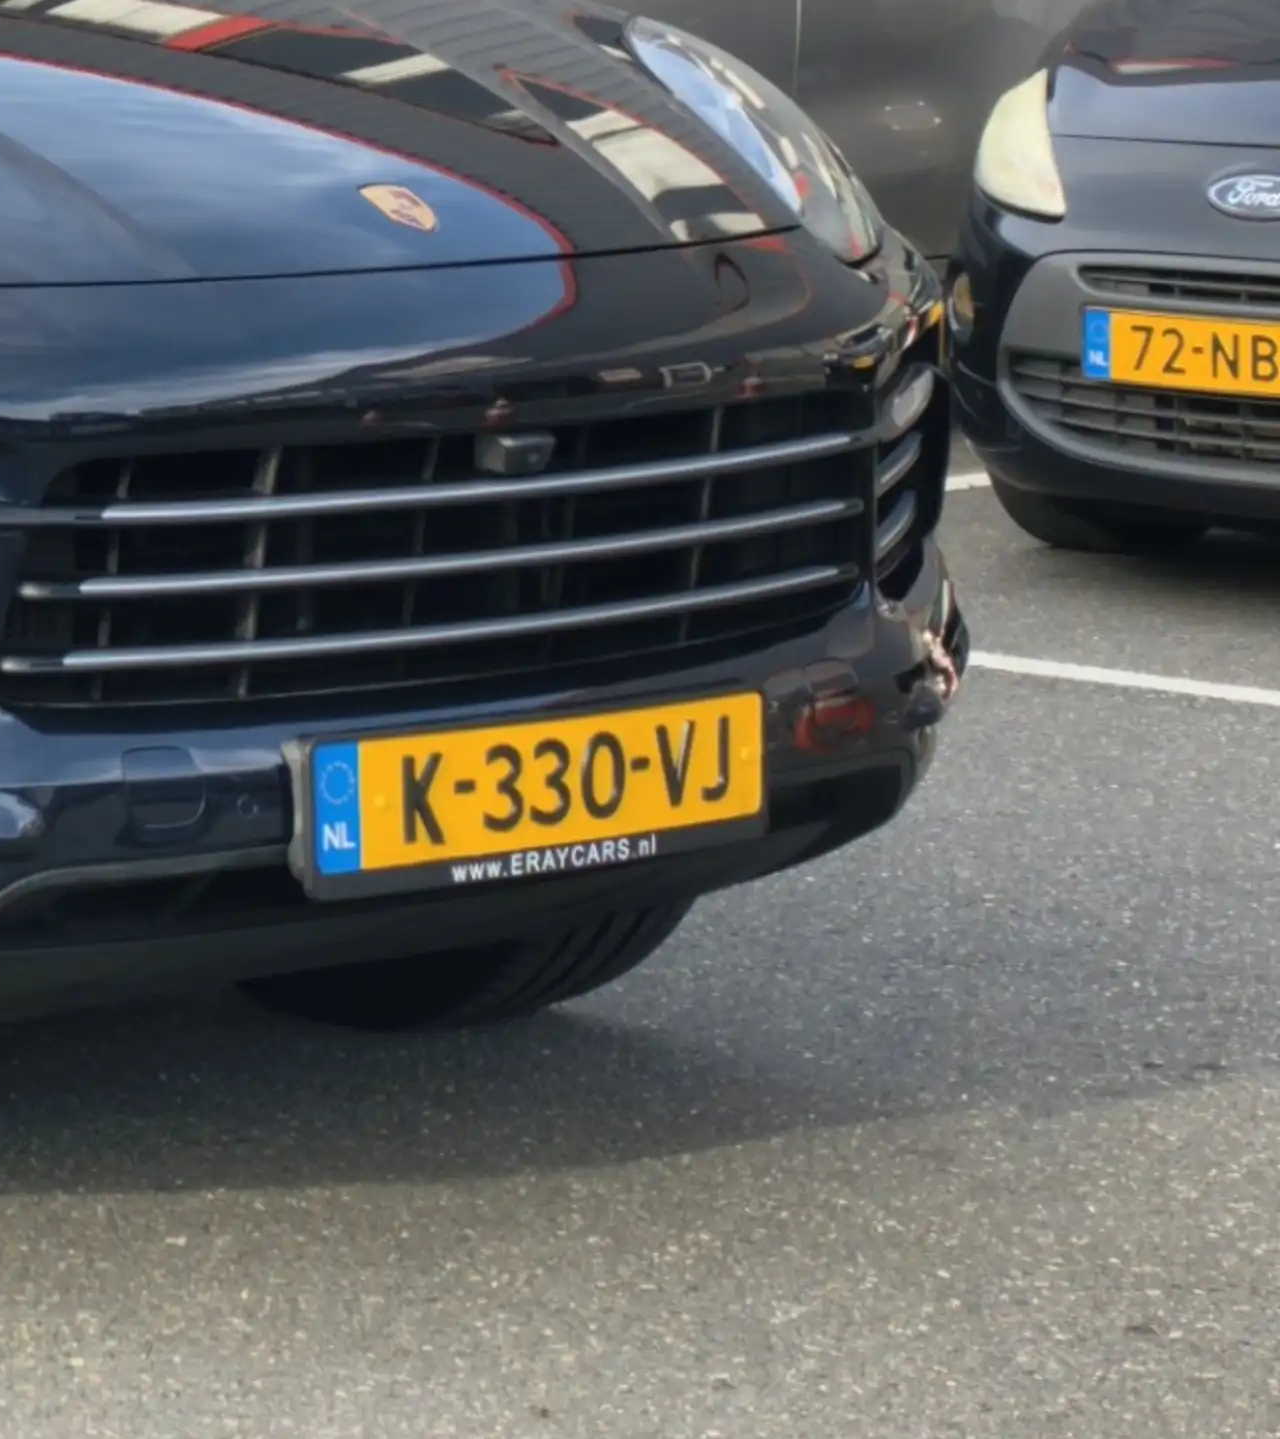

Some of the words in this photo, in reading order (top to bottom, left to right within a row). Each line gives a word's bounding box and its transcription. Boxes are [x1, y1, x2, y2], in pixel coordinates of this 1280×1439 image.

[1088, 349, 1109, 367] NL
[1129, 324, 1280, 383] 72-NB
[322, 821, 356, 852] NL
[401, 715, 730, 846] K-330-VJ
[451, 833, 658, 884] www.ERAYCARS.nl
